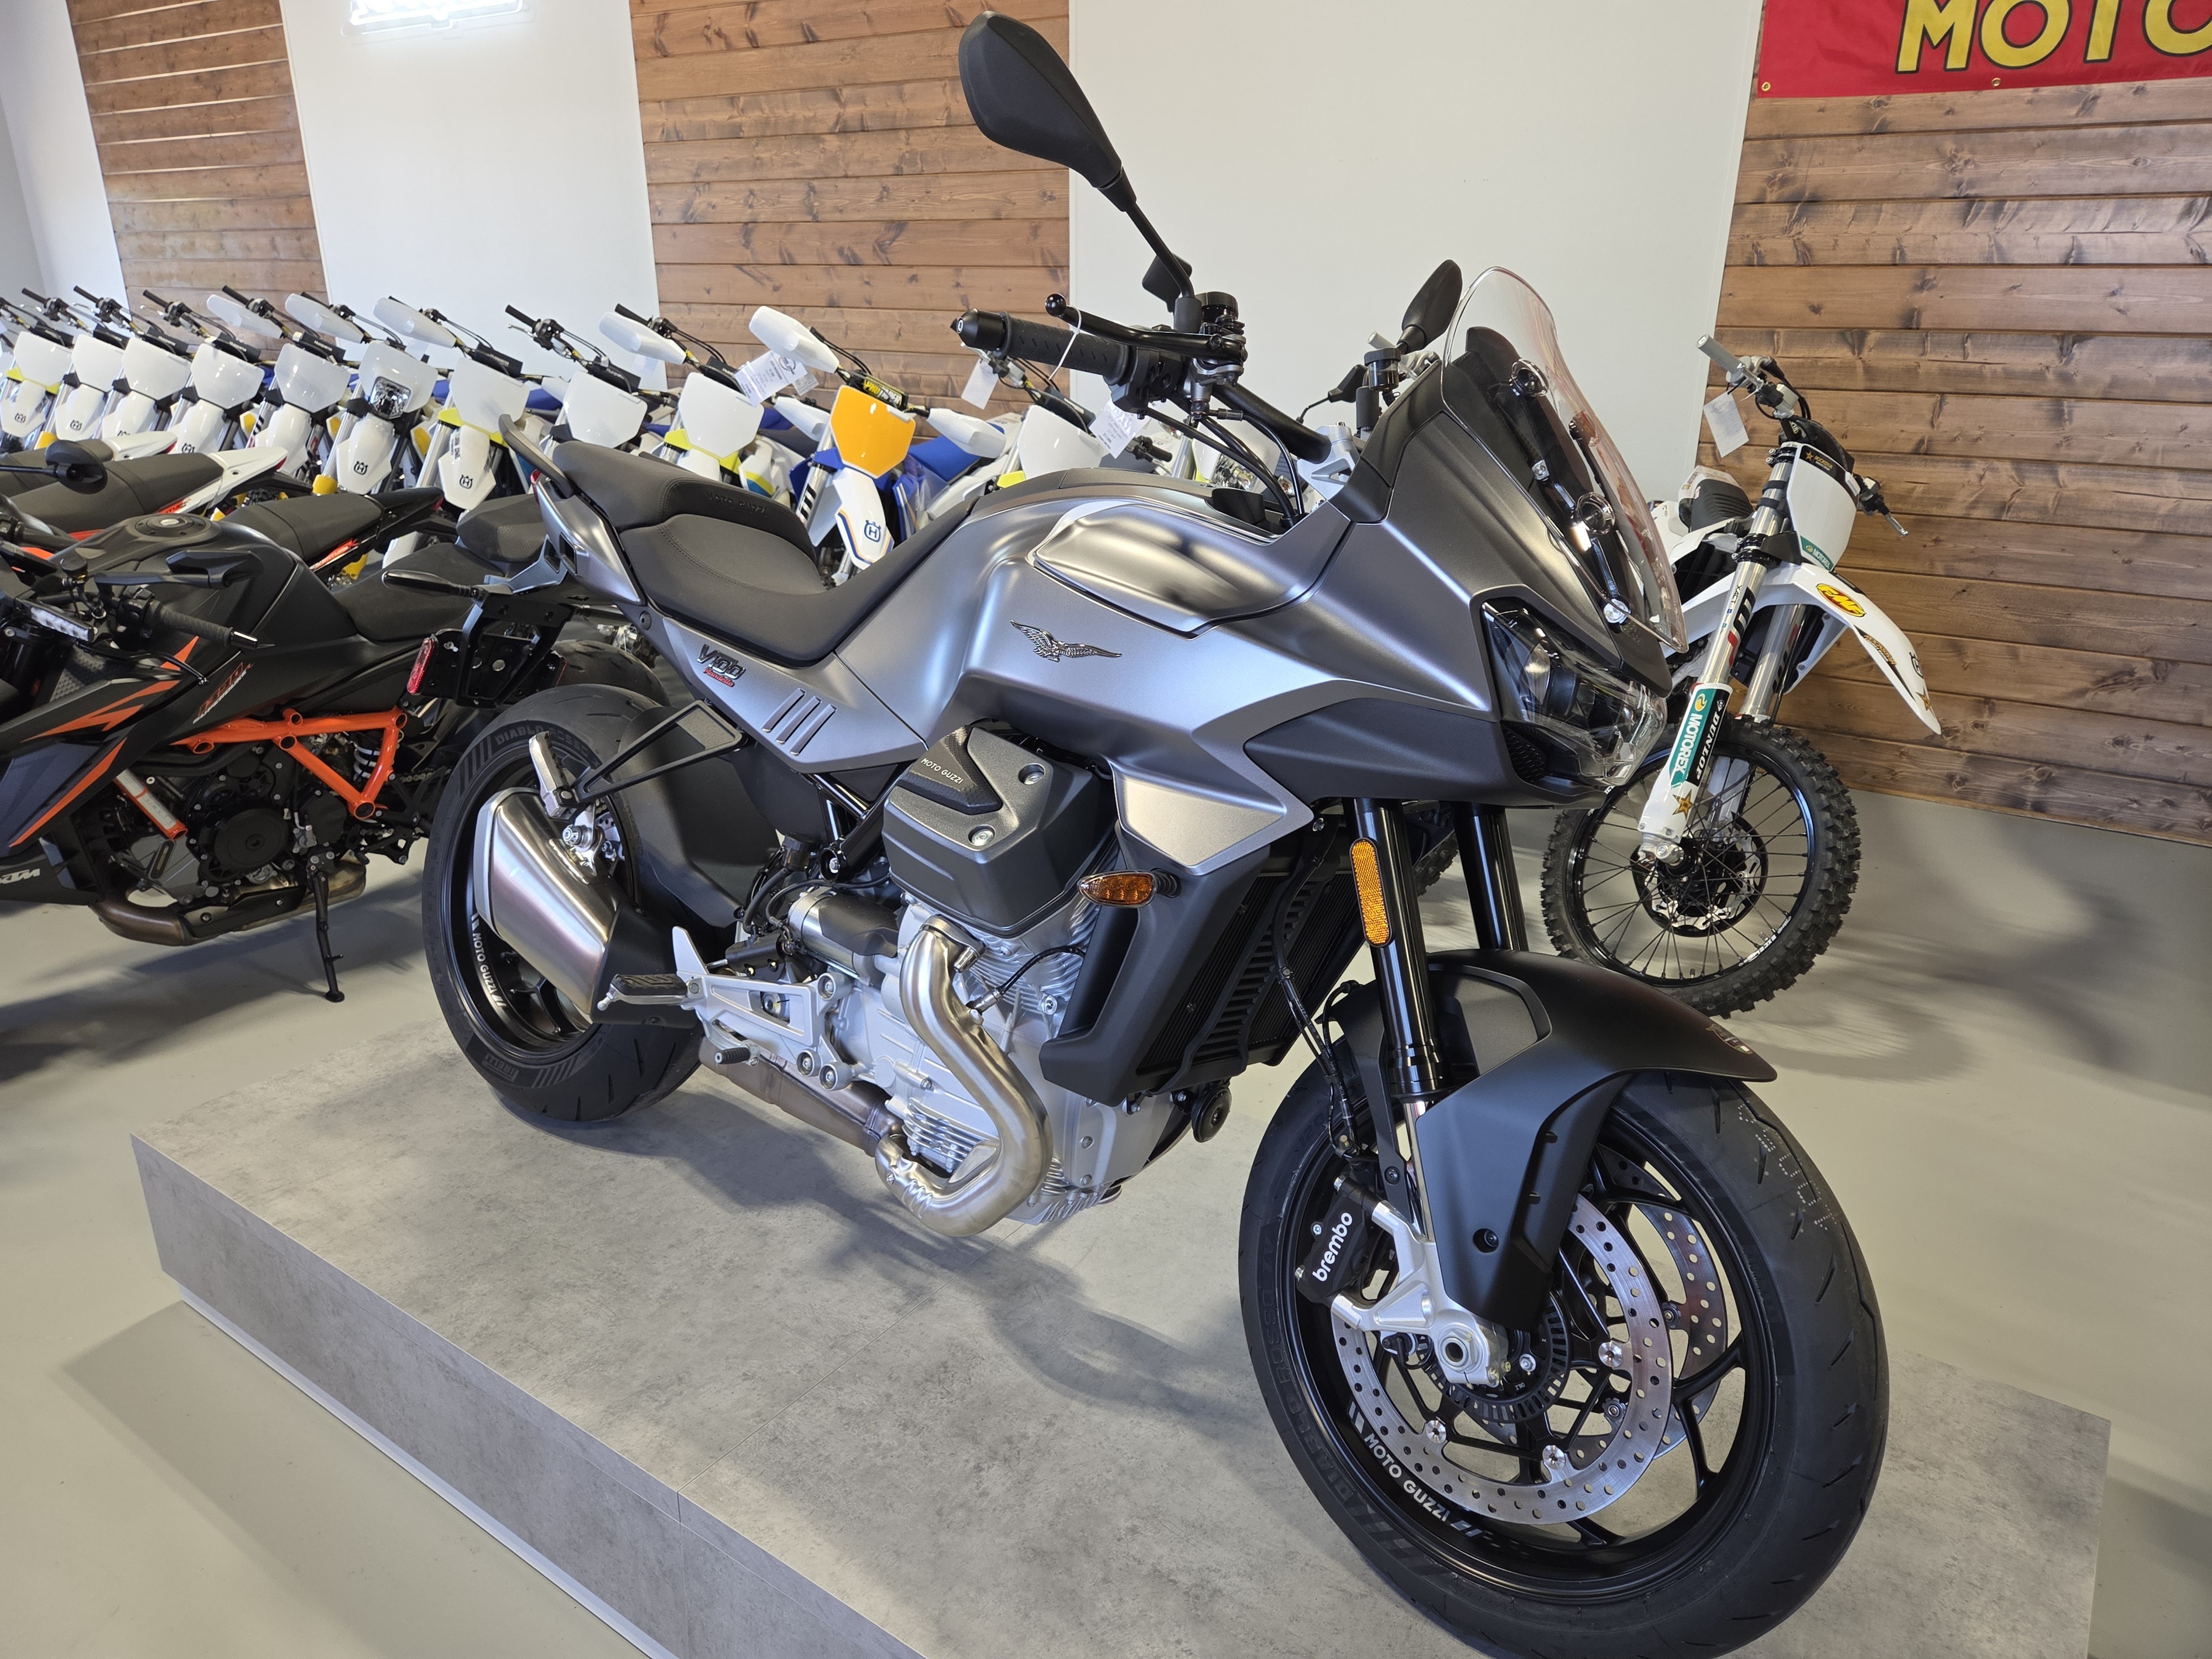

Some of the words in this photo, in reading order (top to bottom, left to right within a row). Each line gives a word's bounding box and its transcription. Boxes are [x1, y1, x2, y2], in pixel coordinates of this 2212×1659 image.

[697, 644, 747, 680] V100
[920, 758, 942, 771] MOTO
[941, 769, 964, 784] GUZZI
[1674, 713, 1703, 775] MOTOREX
[1695, 711, 1720, 780] DUNLOP
[472, 932, 486, 962] MOTO
[479, 964, 498, 994] GUZZI
[1312, 1212, 1353, 1282] brembo
[1364, 1433, 1402, 1478] MOTO
[1403, 1480, 1451, 1522] GUZZI
